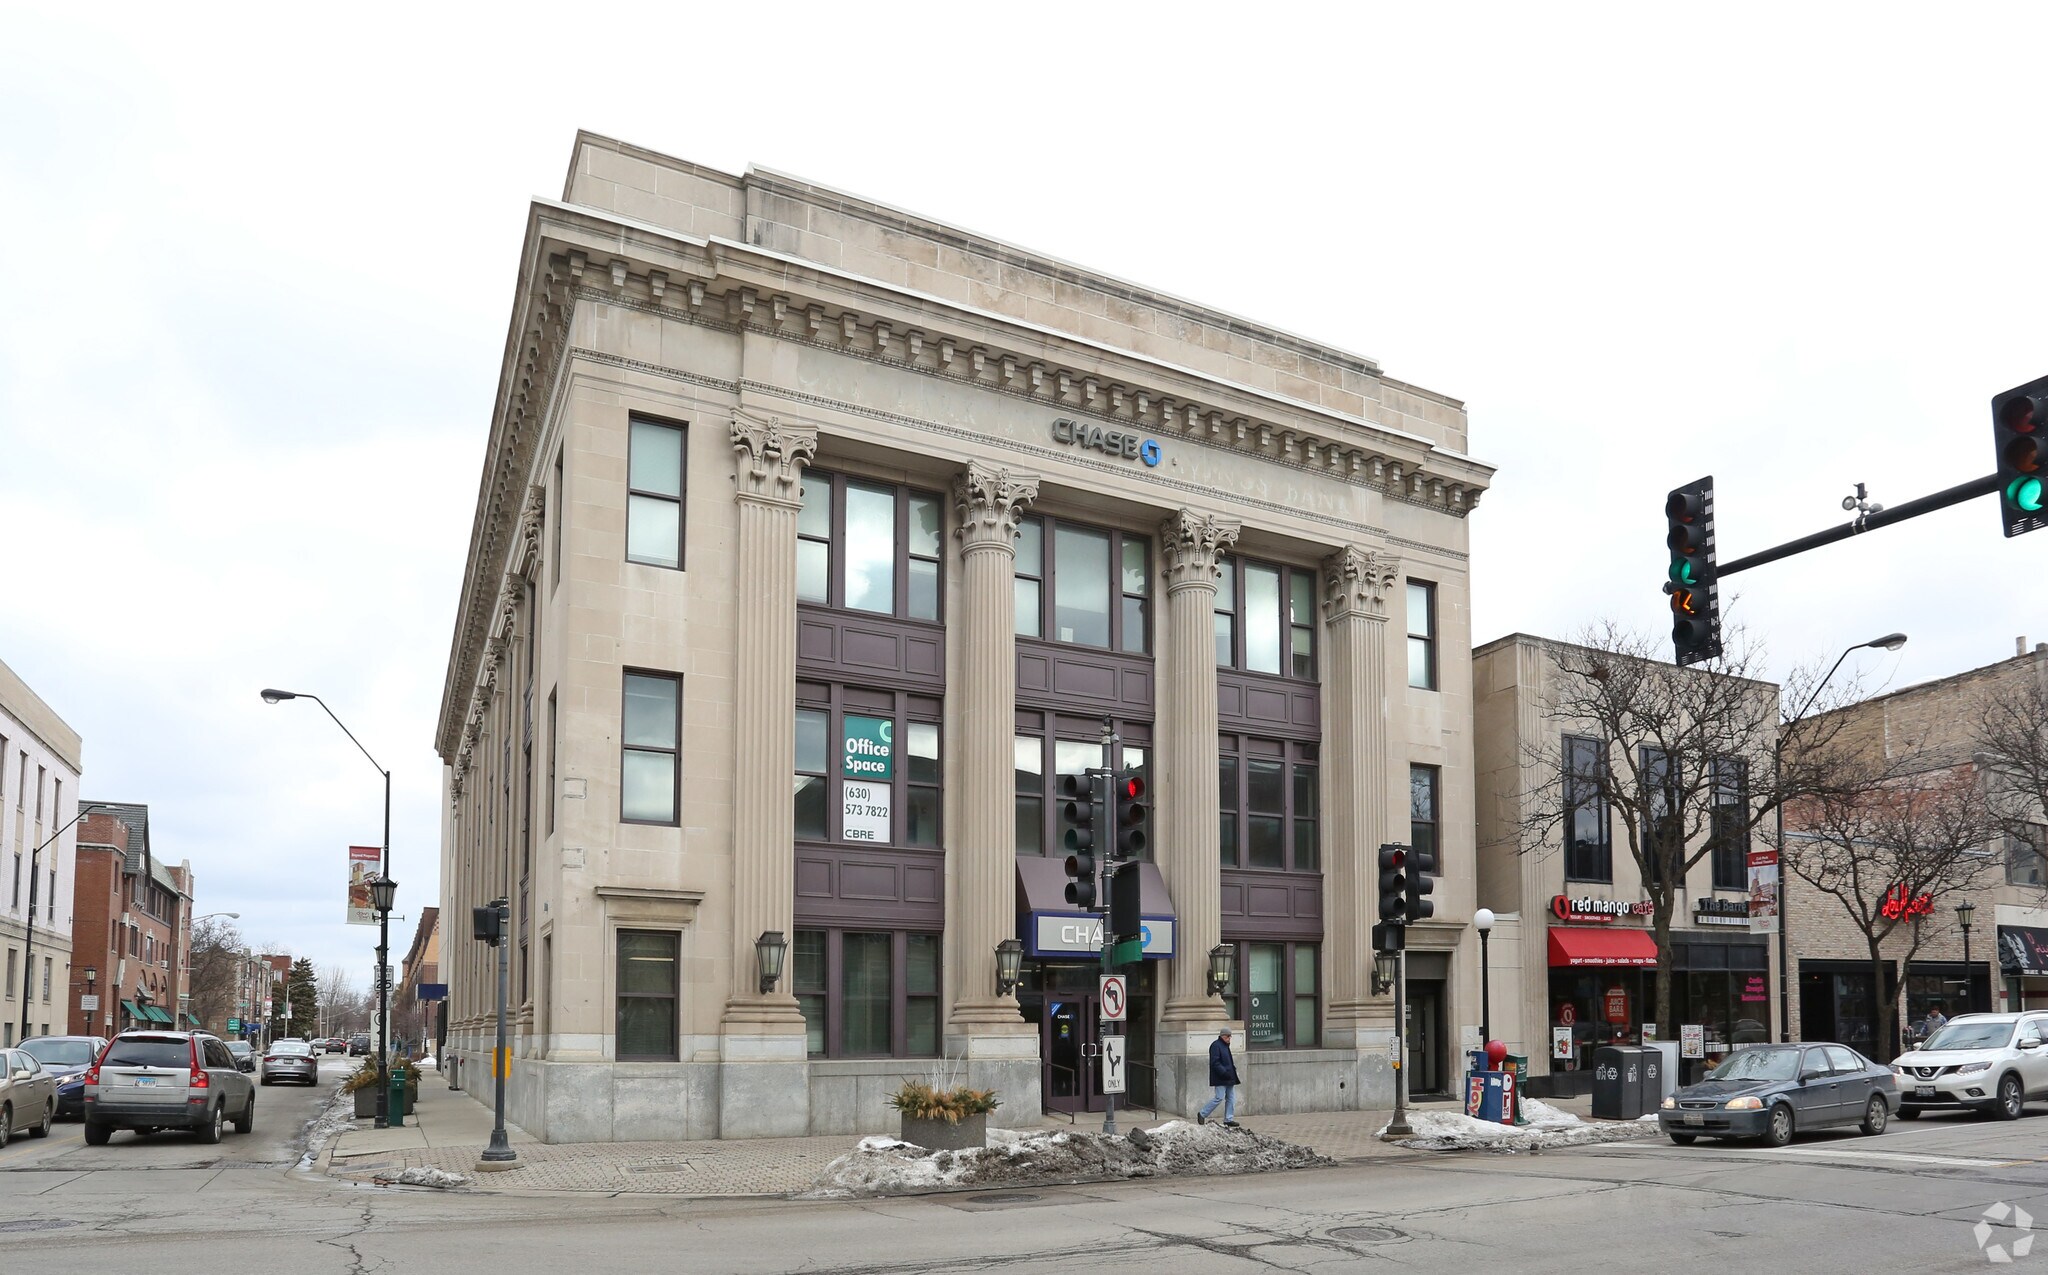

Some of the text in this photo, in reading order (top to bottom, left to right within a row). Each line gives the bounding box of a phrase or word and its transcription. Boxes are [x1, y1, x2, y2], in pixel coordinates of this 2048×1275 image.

[1052, 417, 1139, 460] CHASE
[846, 738, 889, 757] Office
[846, 755, 885, 773] Space
[845, 786, 871, 802] (630)
[845, 803, 888, 818] 573 7822
[845, 829, 874, 840] CBRE
[1571, 897, 1591, 912] red
[1593, 899, 1630, 917] mango
[1702, 899, 1747, 912] The Barre
[1062, 925, 1104, 944] CHA
[1107, 1080, 1120, 1088] ONLY
[1467, 1077, 1485, 1117] Hoy
